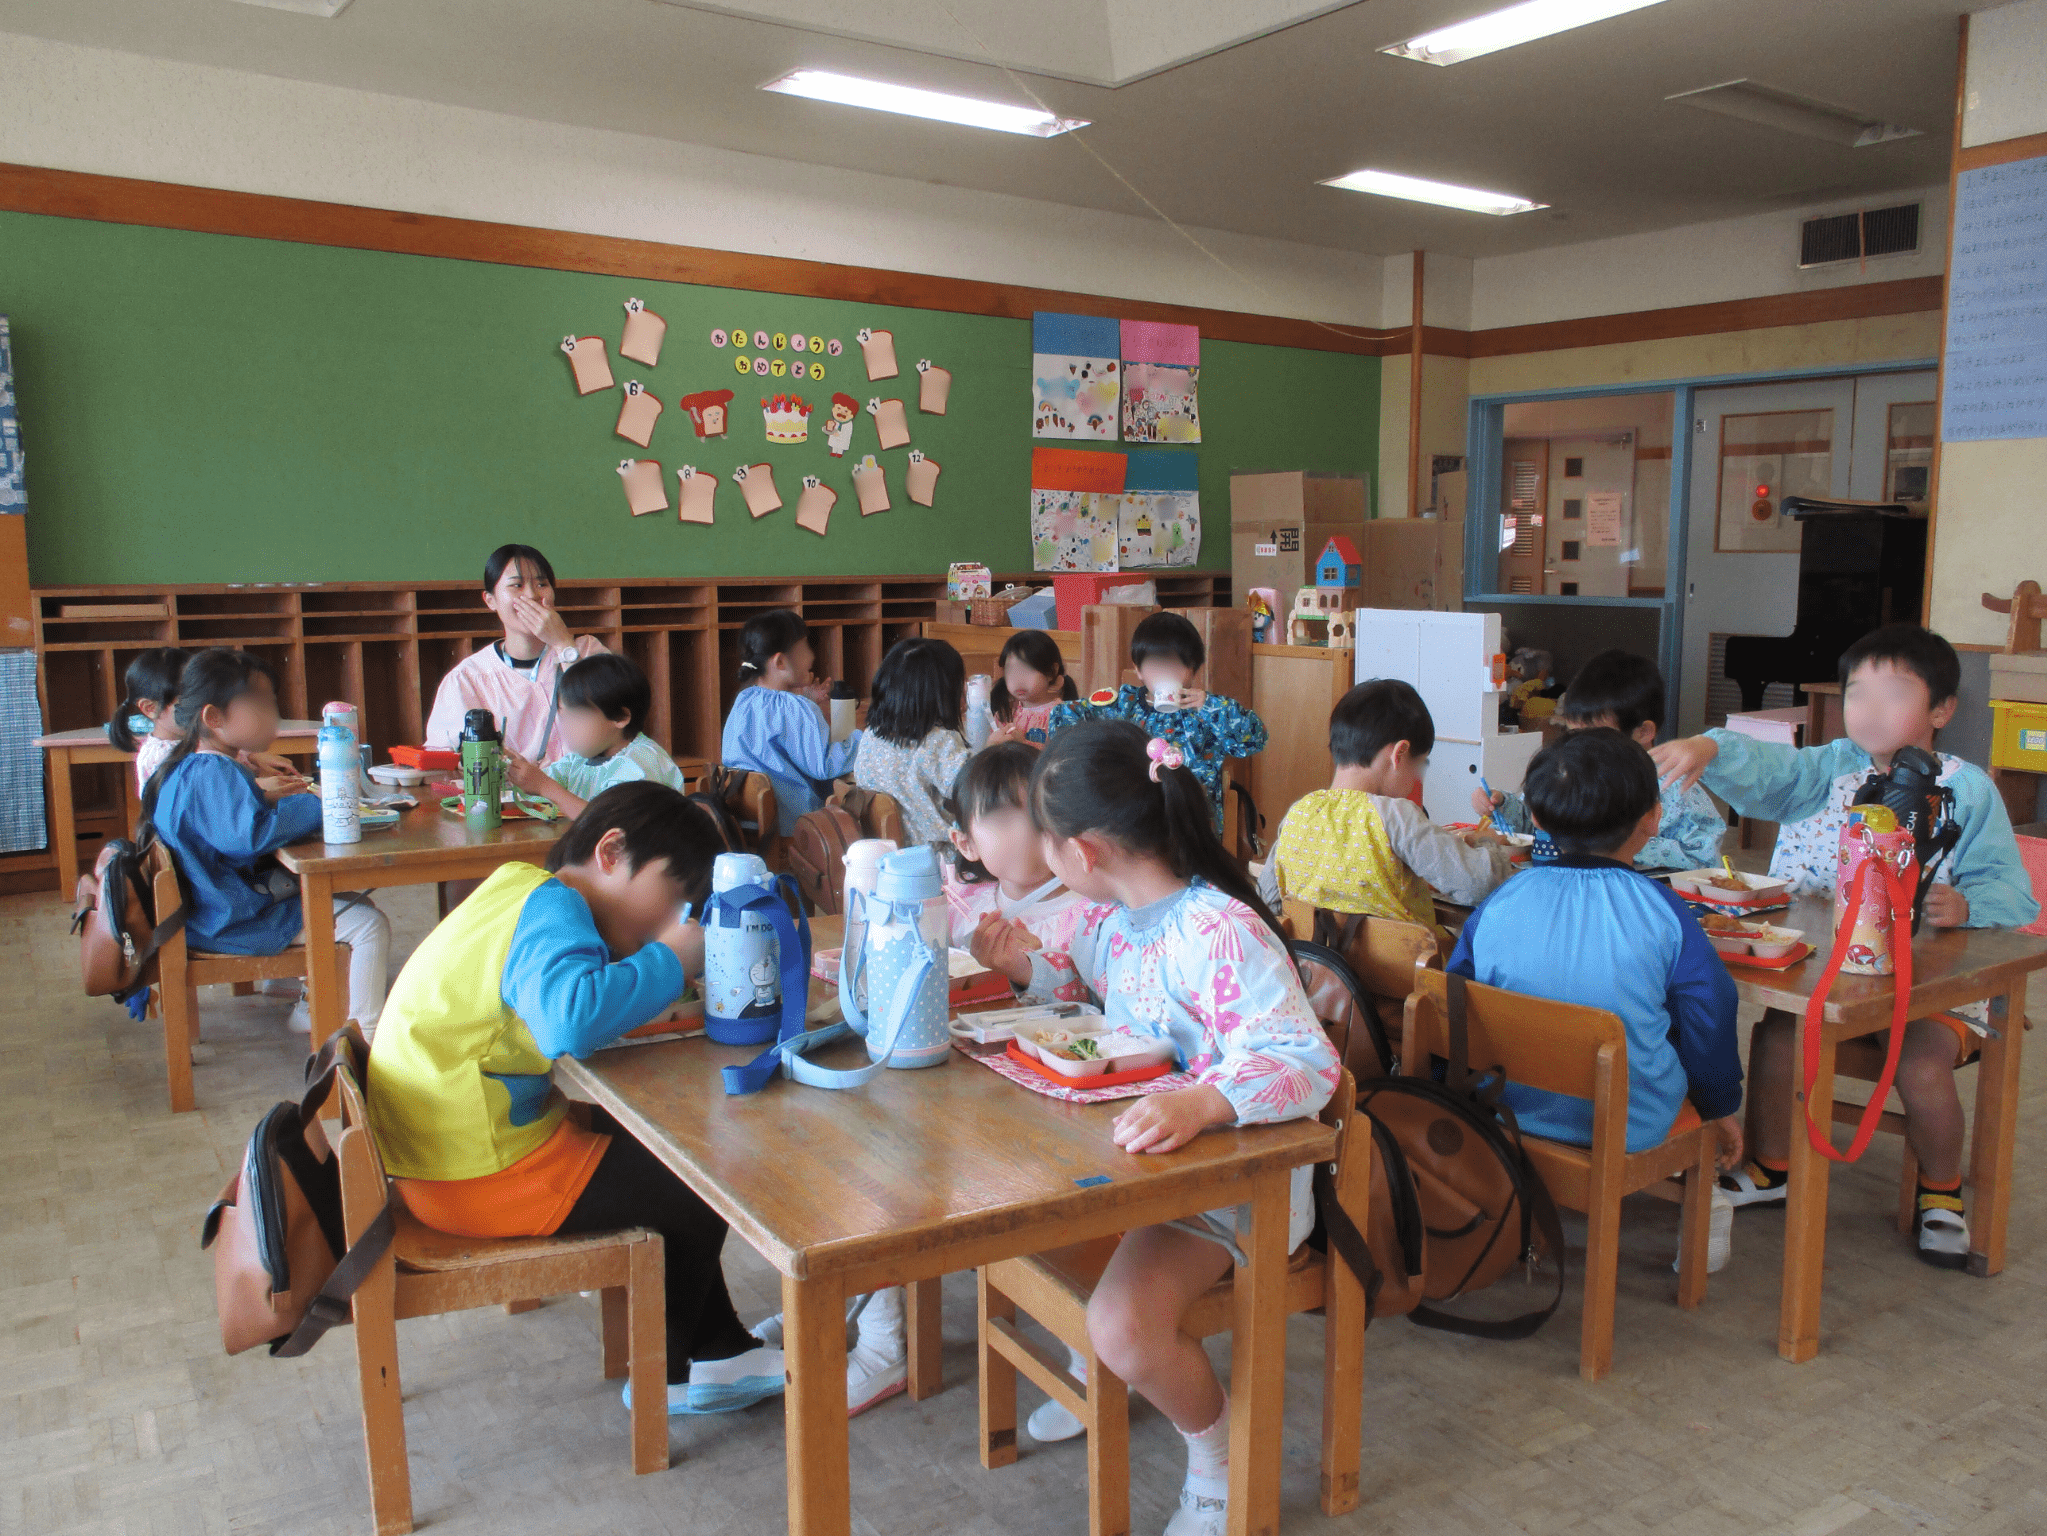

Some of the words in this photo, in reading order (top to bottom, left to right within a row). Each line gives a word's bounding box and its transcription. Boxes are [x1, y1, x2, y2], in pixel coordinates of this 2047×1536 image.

[630, 302, 639, 312] 4
[862, 332, 869, 341] 3
[565, 338, 575, 351] 5
[713, 333, 840, 355] おたんじょうび
[738, 361, 821, 379] おめでとう
[921, 361, 929, 372] 2
[629, 382, 638, 395] 6
[912, 455, 921, 463] 12
[684, 469, 691, 479] 8
[737, 468, 746, 479] 9
[806, 479, 816, 488] 10
[1279, 528, 1299, 551] 開
